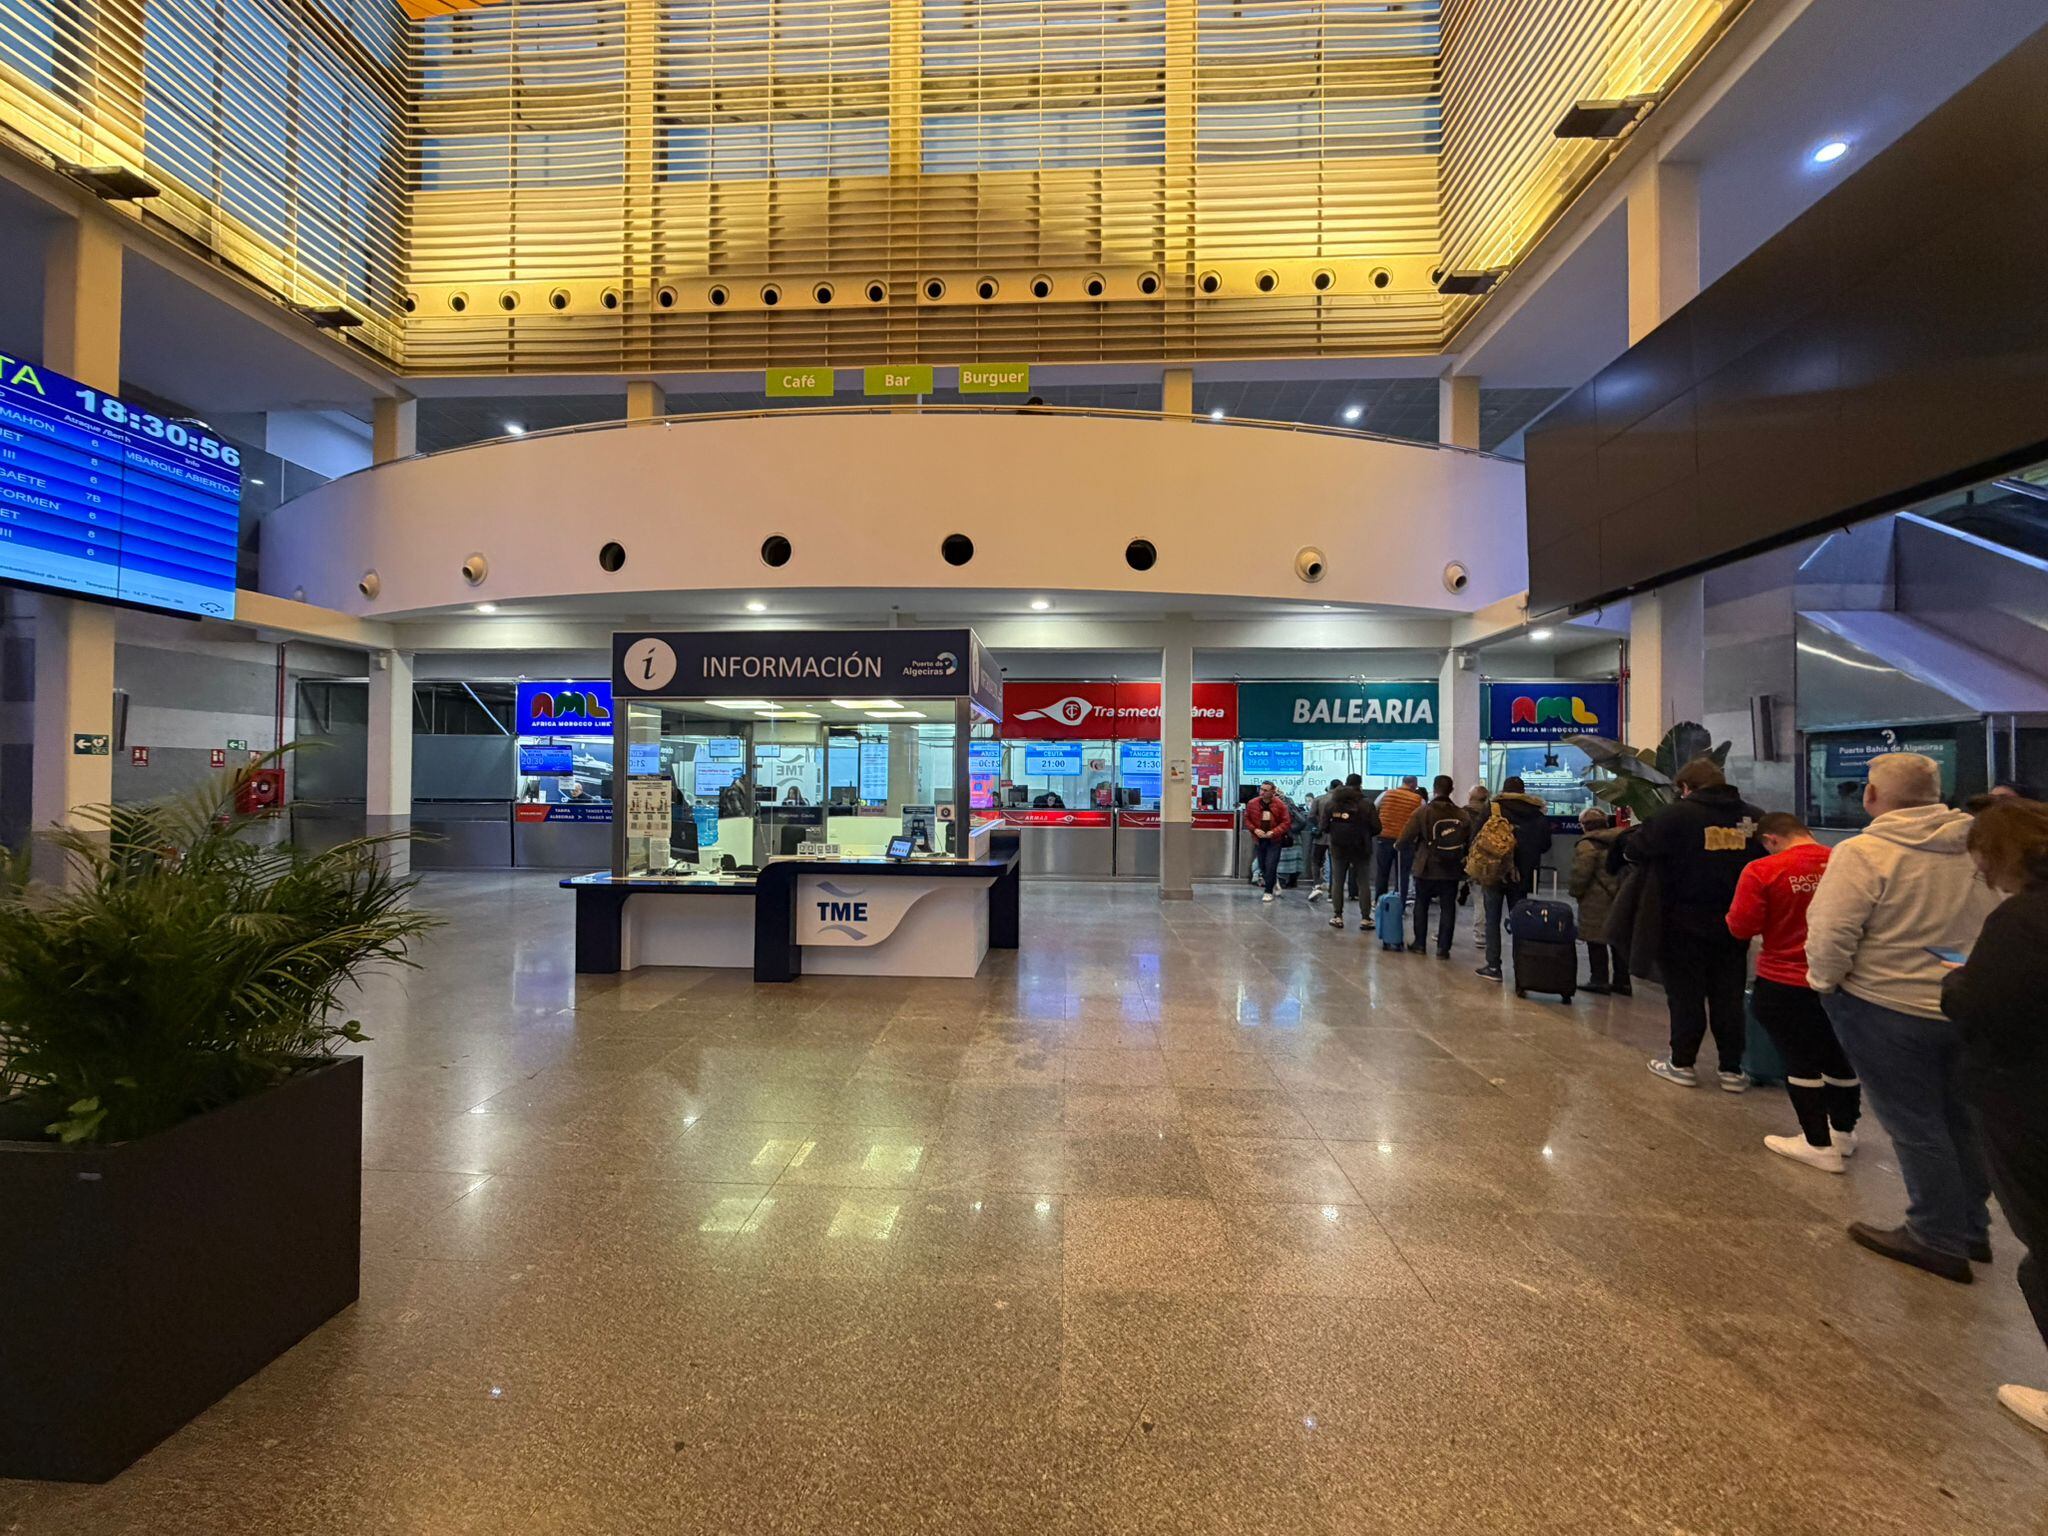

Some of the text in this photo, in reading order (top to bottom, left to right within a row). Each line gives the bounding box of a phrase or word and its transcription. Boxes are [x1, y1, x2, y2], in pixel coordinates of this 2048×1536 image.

[783, 375, 816, 388] Café
[885, 374, 911, 387] Bar
[962, 370, 1025, 386] Burguer
[75, 389, 241, 467] 18:30:56
[702, 651, 882, 678] INFORMACIÓN
[902, 667, 944, 677] Algeciras
[1839, 746, 1864, 754] Puerto
[1890, 744, 1901, 753] de
[1903, 743, 1944, 753] Algeciras
[1041, 760, 1066, 768] 21:00
[1136, 760, 1161, 768] 21:30
[817, 902, 868, 922] TME
